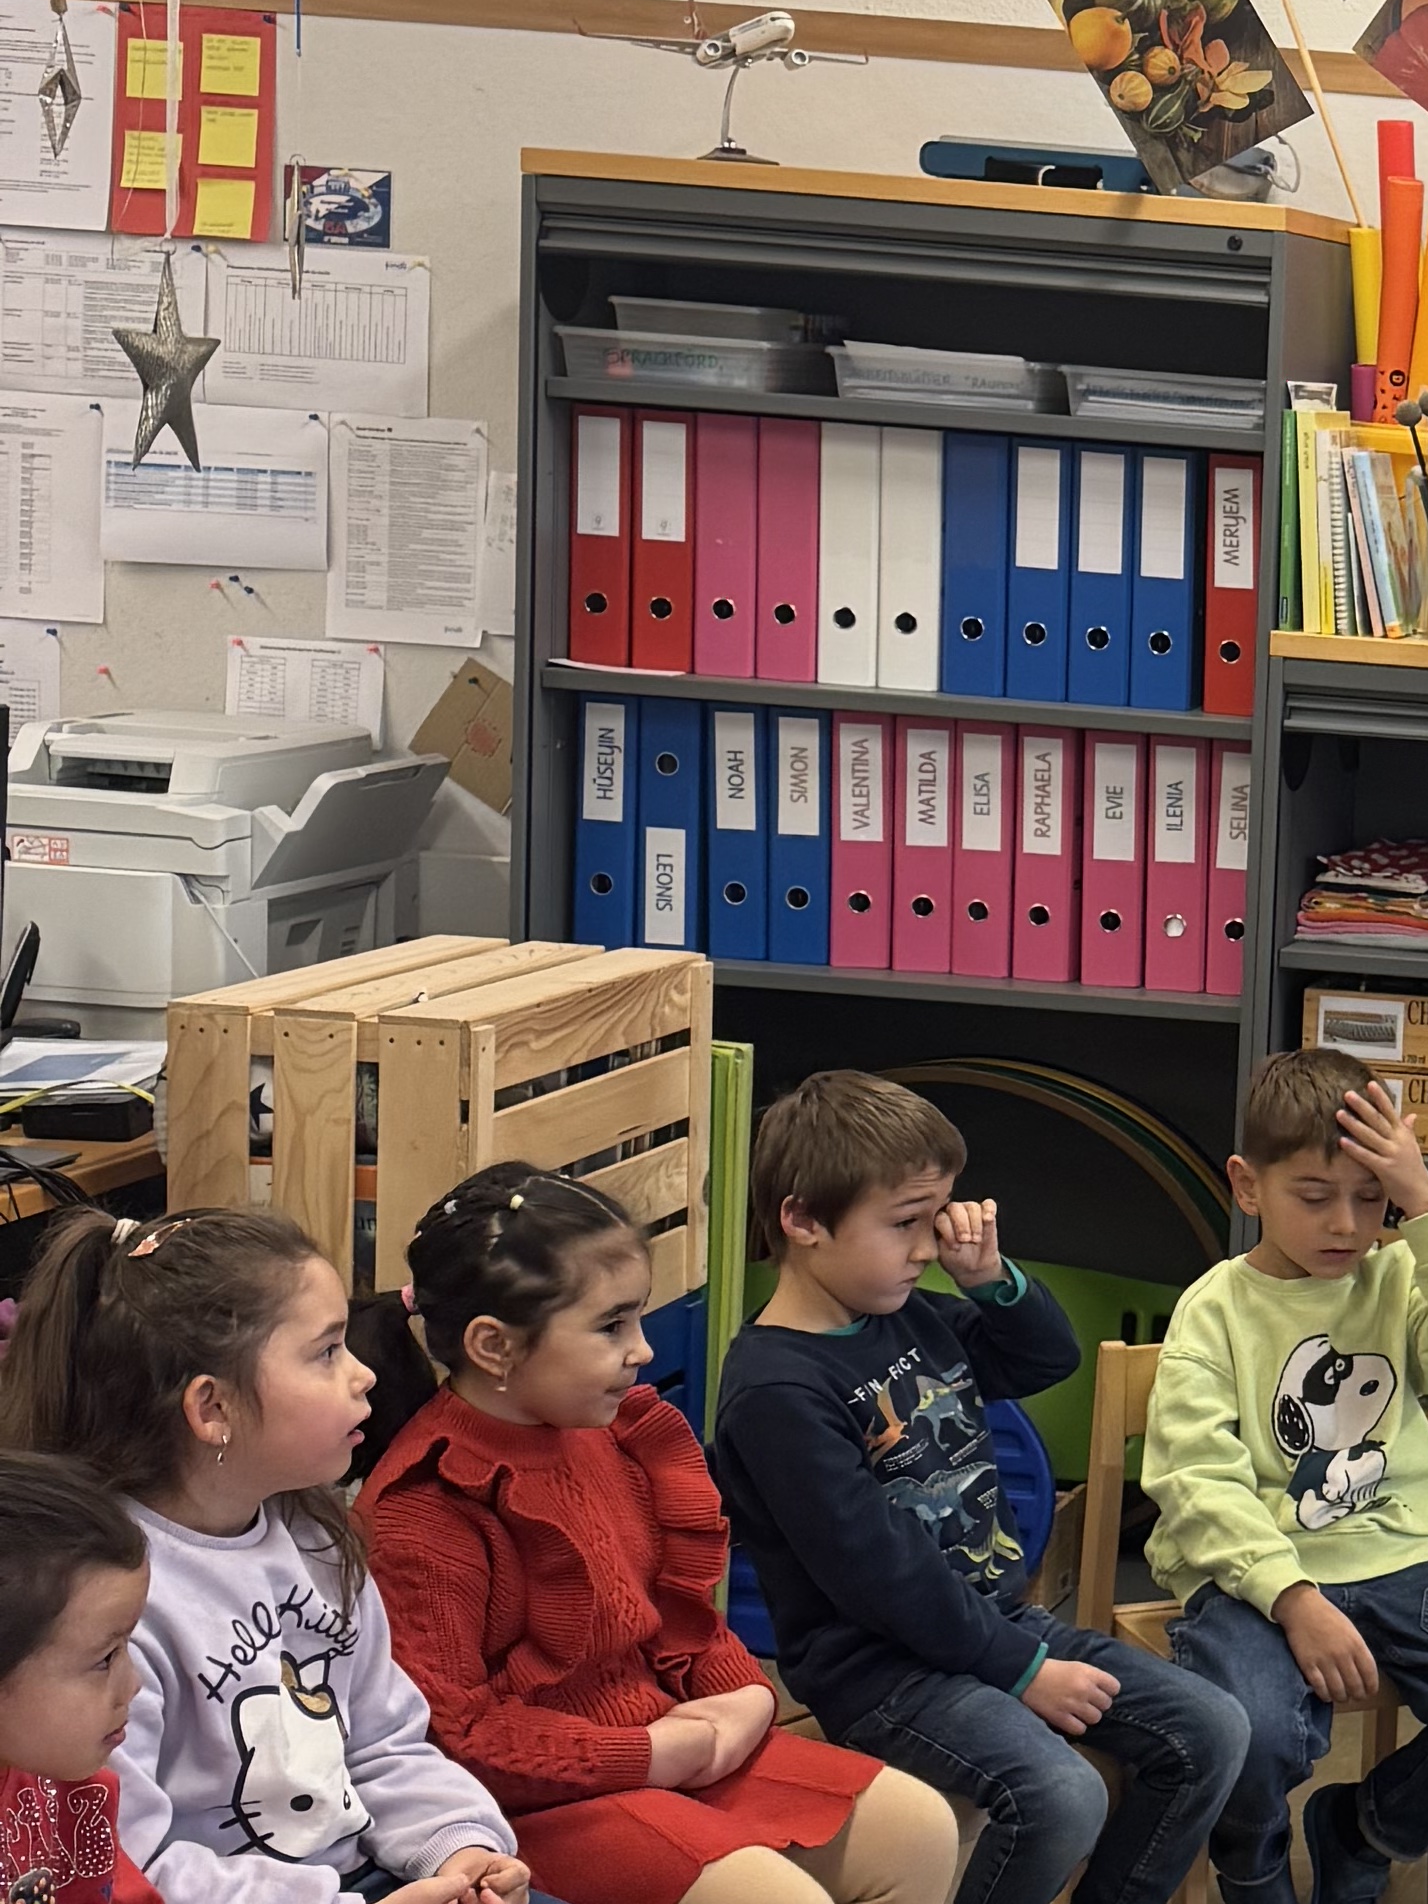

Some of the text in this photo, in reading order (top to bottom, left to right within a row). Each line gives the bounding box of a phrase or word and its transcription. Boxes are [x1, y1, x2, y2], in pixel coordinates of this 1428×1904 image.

[726, 749, 745, 800] NOAH
[790, 746, 808, 804] SIMON
[850, 737, 871, 831] VALENTINA
[917, 749, 938, 826] MATILDA
[972, 771, 991, 817] ELISA
[1033, 751, 1053, 838] RAPHAELA
[1105, 784, 1124, 820] EVIE
[1165, 779, 1184, 832] ILENIA
[1228, 783, 1250, 842] SELINA
[655, 852, 674, 913] LEONIS
[197, 1601, 282, 1704] Hell
